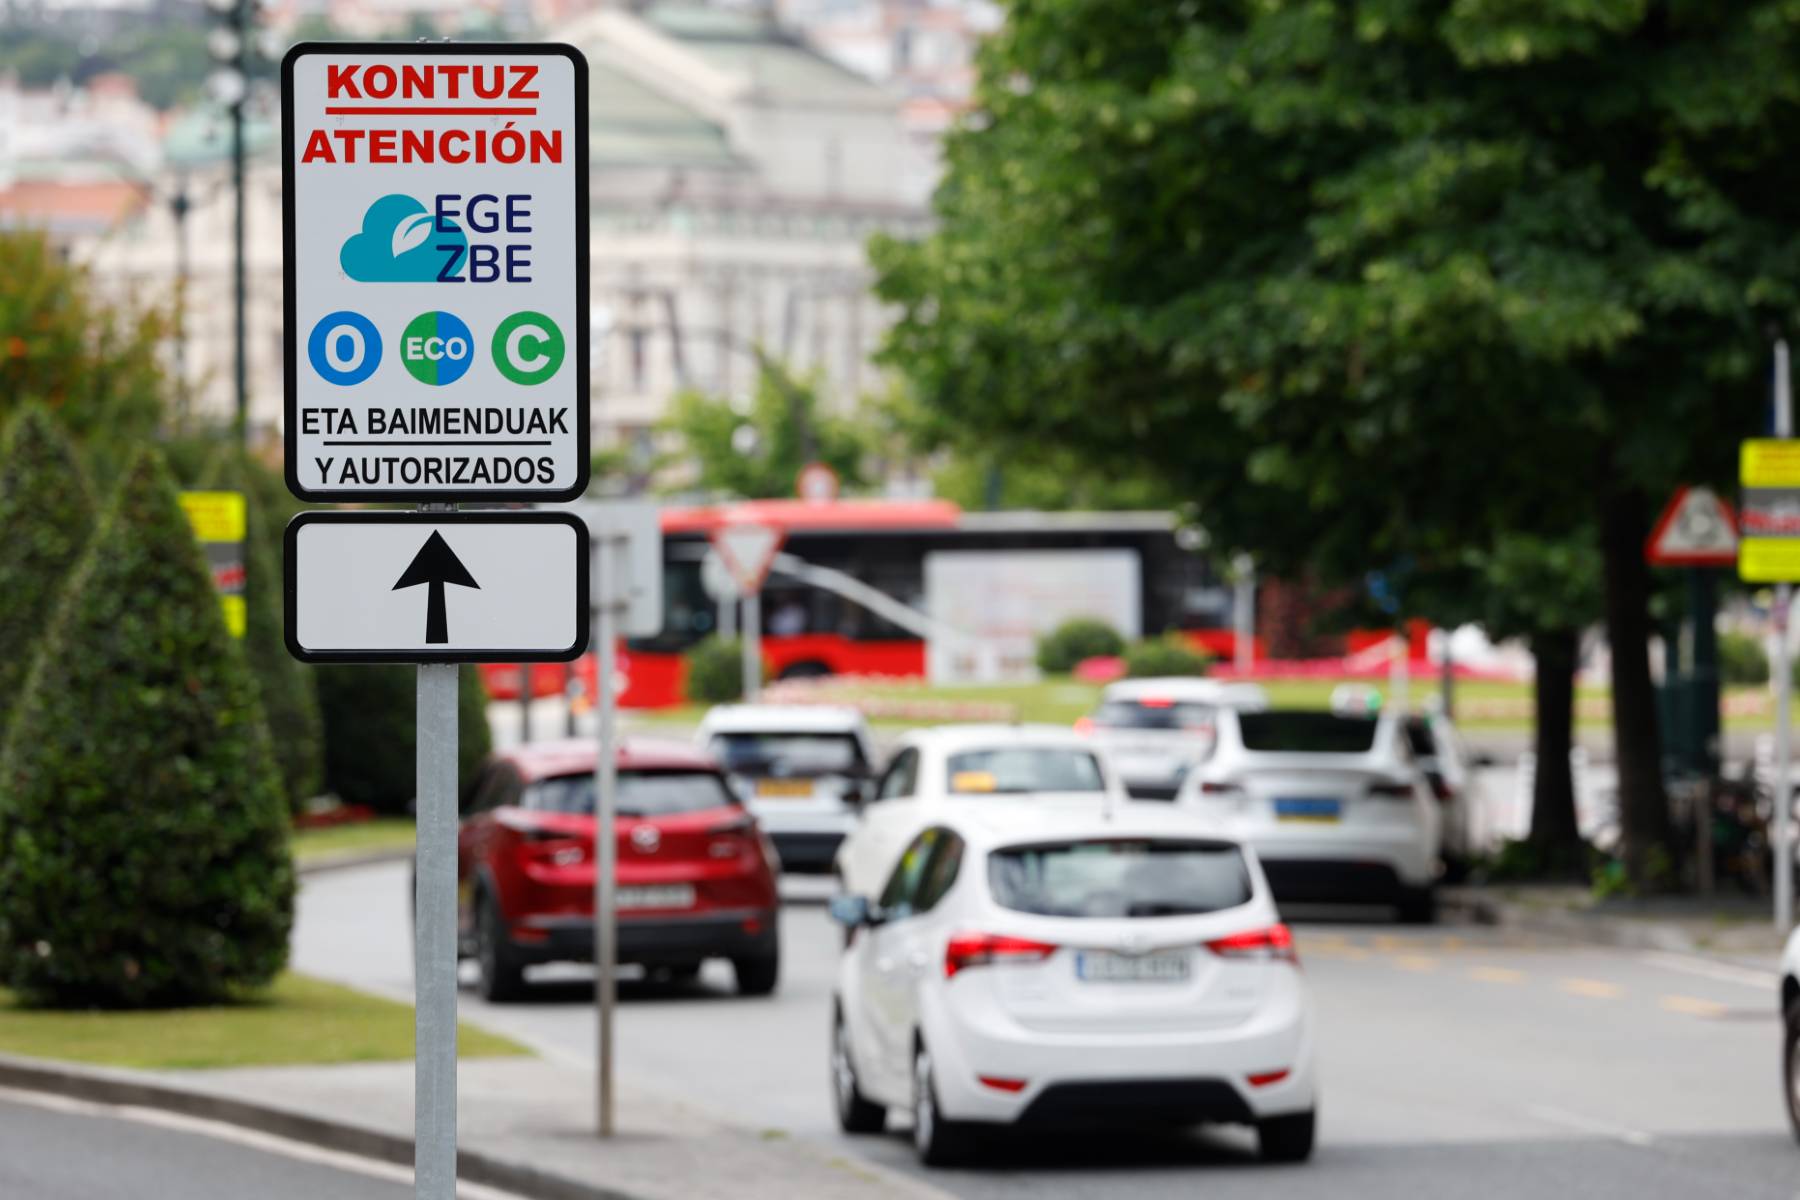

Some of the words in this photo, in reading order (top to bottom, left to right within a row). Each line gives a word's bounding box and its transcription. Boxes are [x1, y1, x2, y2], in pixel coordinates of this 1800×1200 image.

[327, 64, 540, 99] KONTUZ
[301, 121, 562, 164] ATENCIÓN
[435, 194, 532, 233] EGE
[436, 244, 532, 283] ZBE
[406, 336, 468, 361] ECO
[505, 324, 551, 373] C
[302, 407, 358, 435] ETA
[367, 407, 569, 435] BAIMENDUAK
[315, 457, 334, 484] Y
[339, 456, 556, 485] AUTORIZADOS
